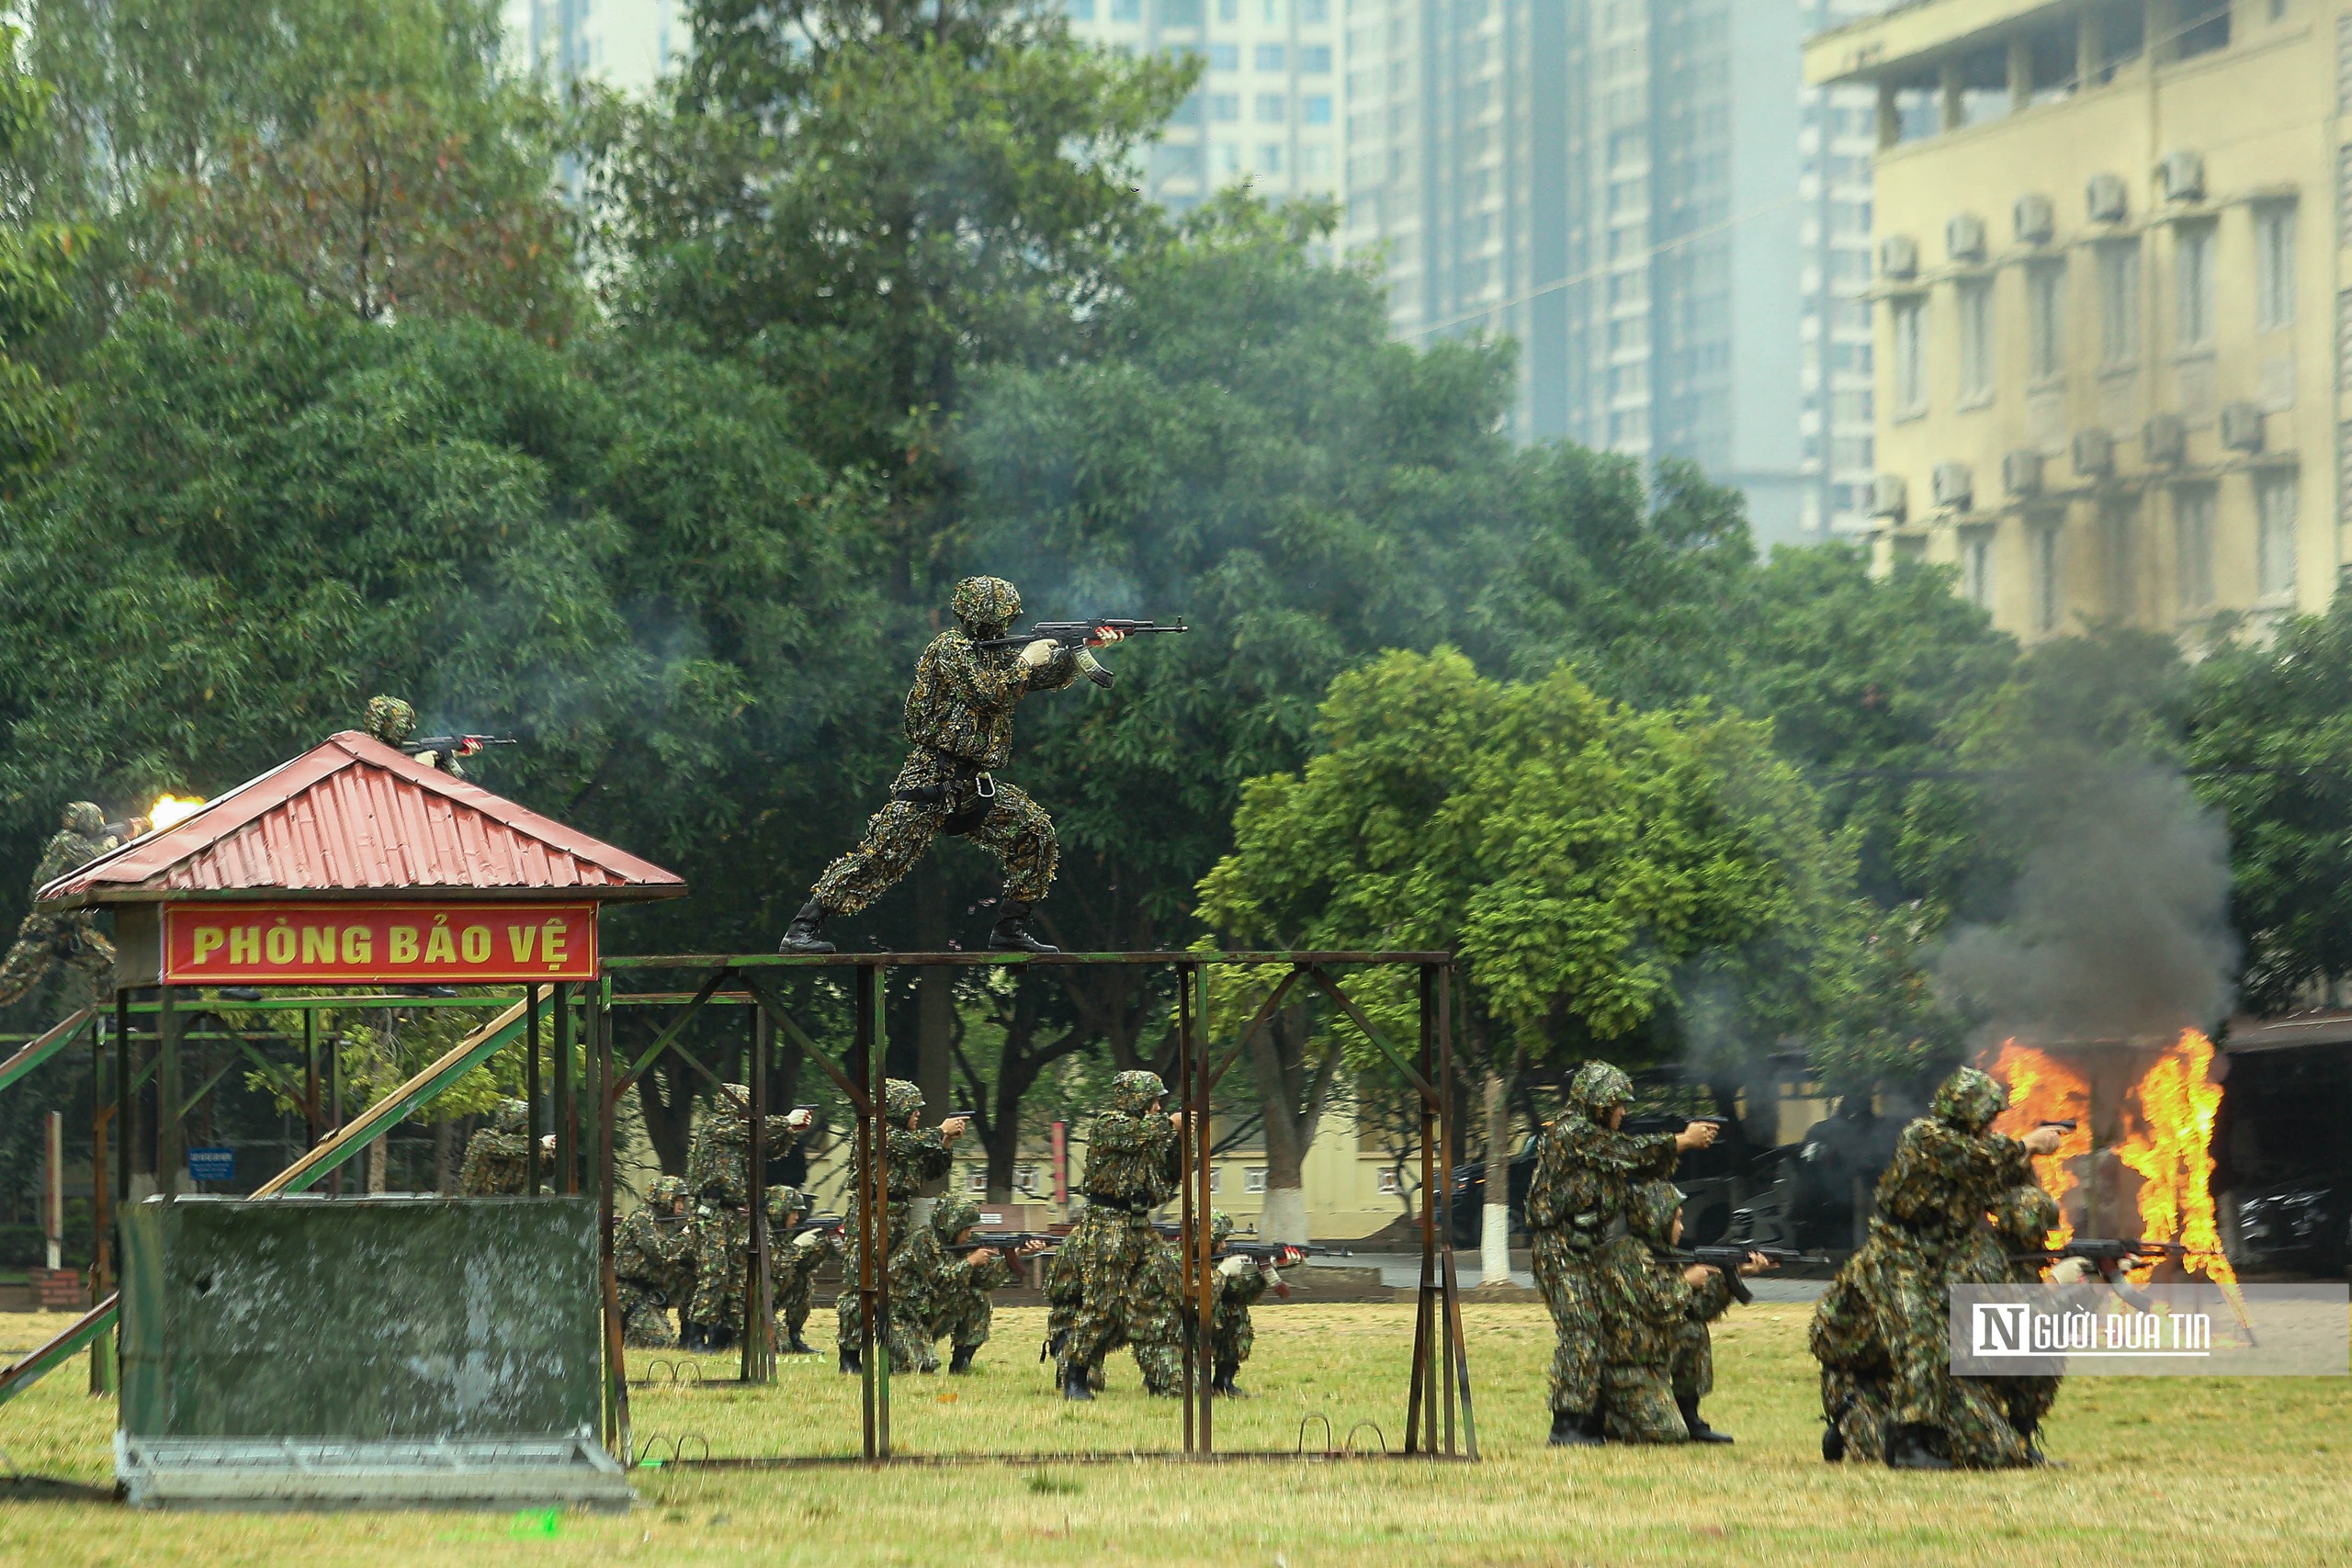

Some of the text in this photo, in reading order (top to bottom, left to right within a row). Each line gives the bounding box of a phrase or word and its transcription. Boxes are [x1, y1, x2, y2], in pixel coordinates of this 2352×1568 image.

[193, 914, 568, 971] PHÒNG BẢO VỆ
